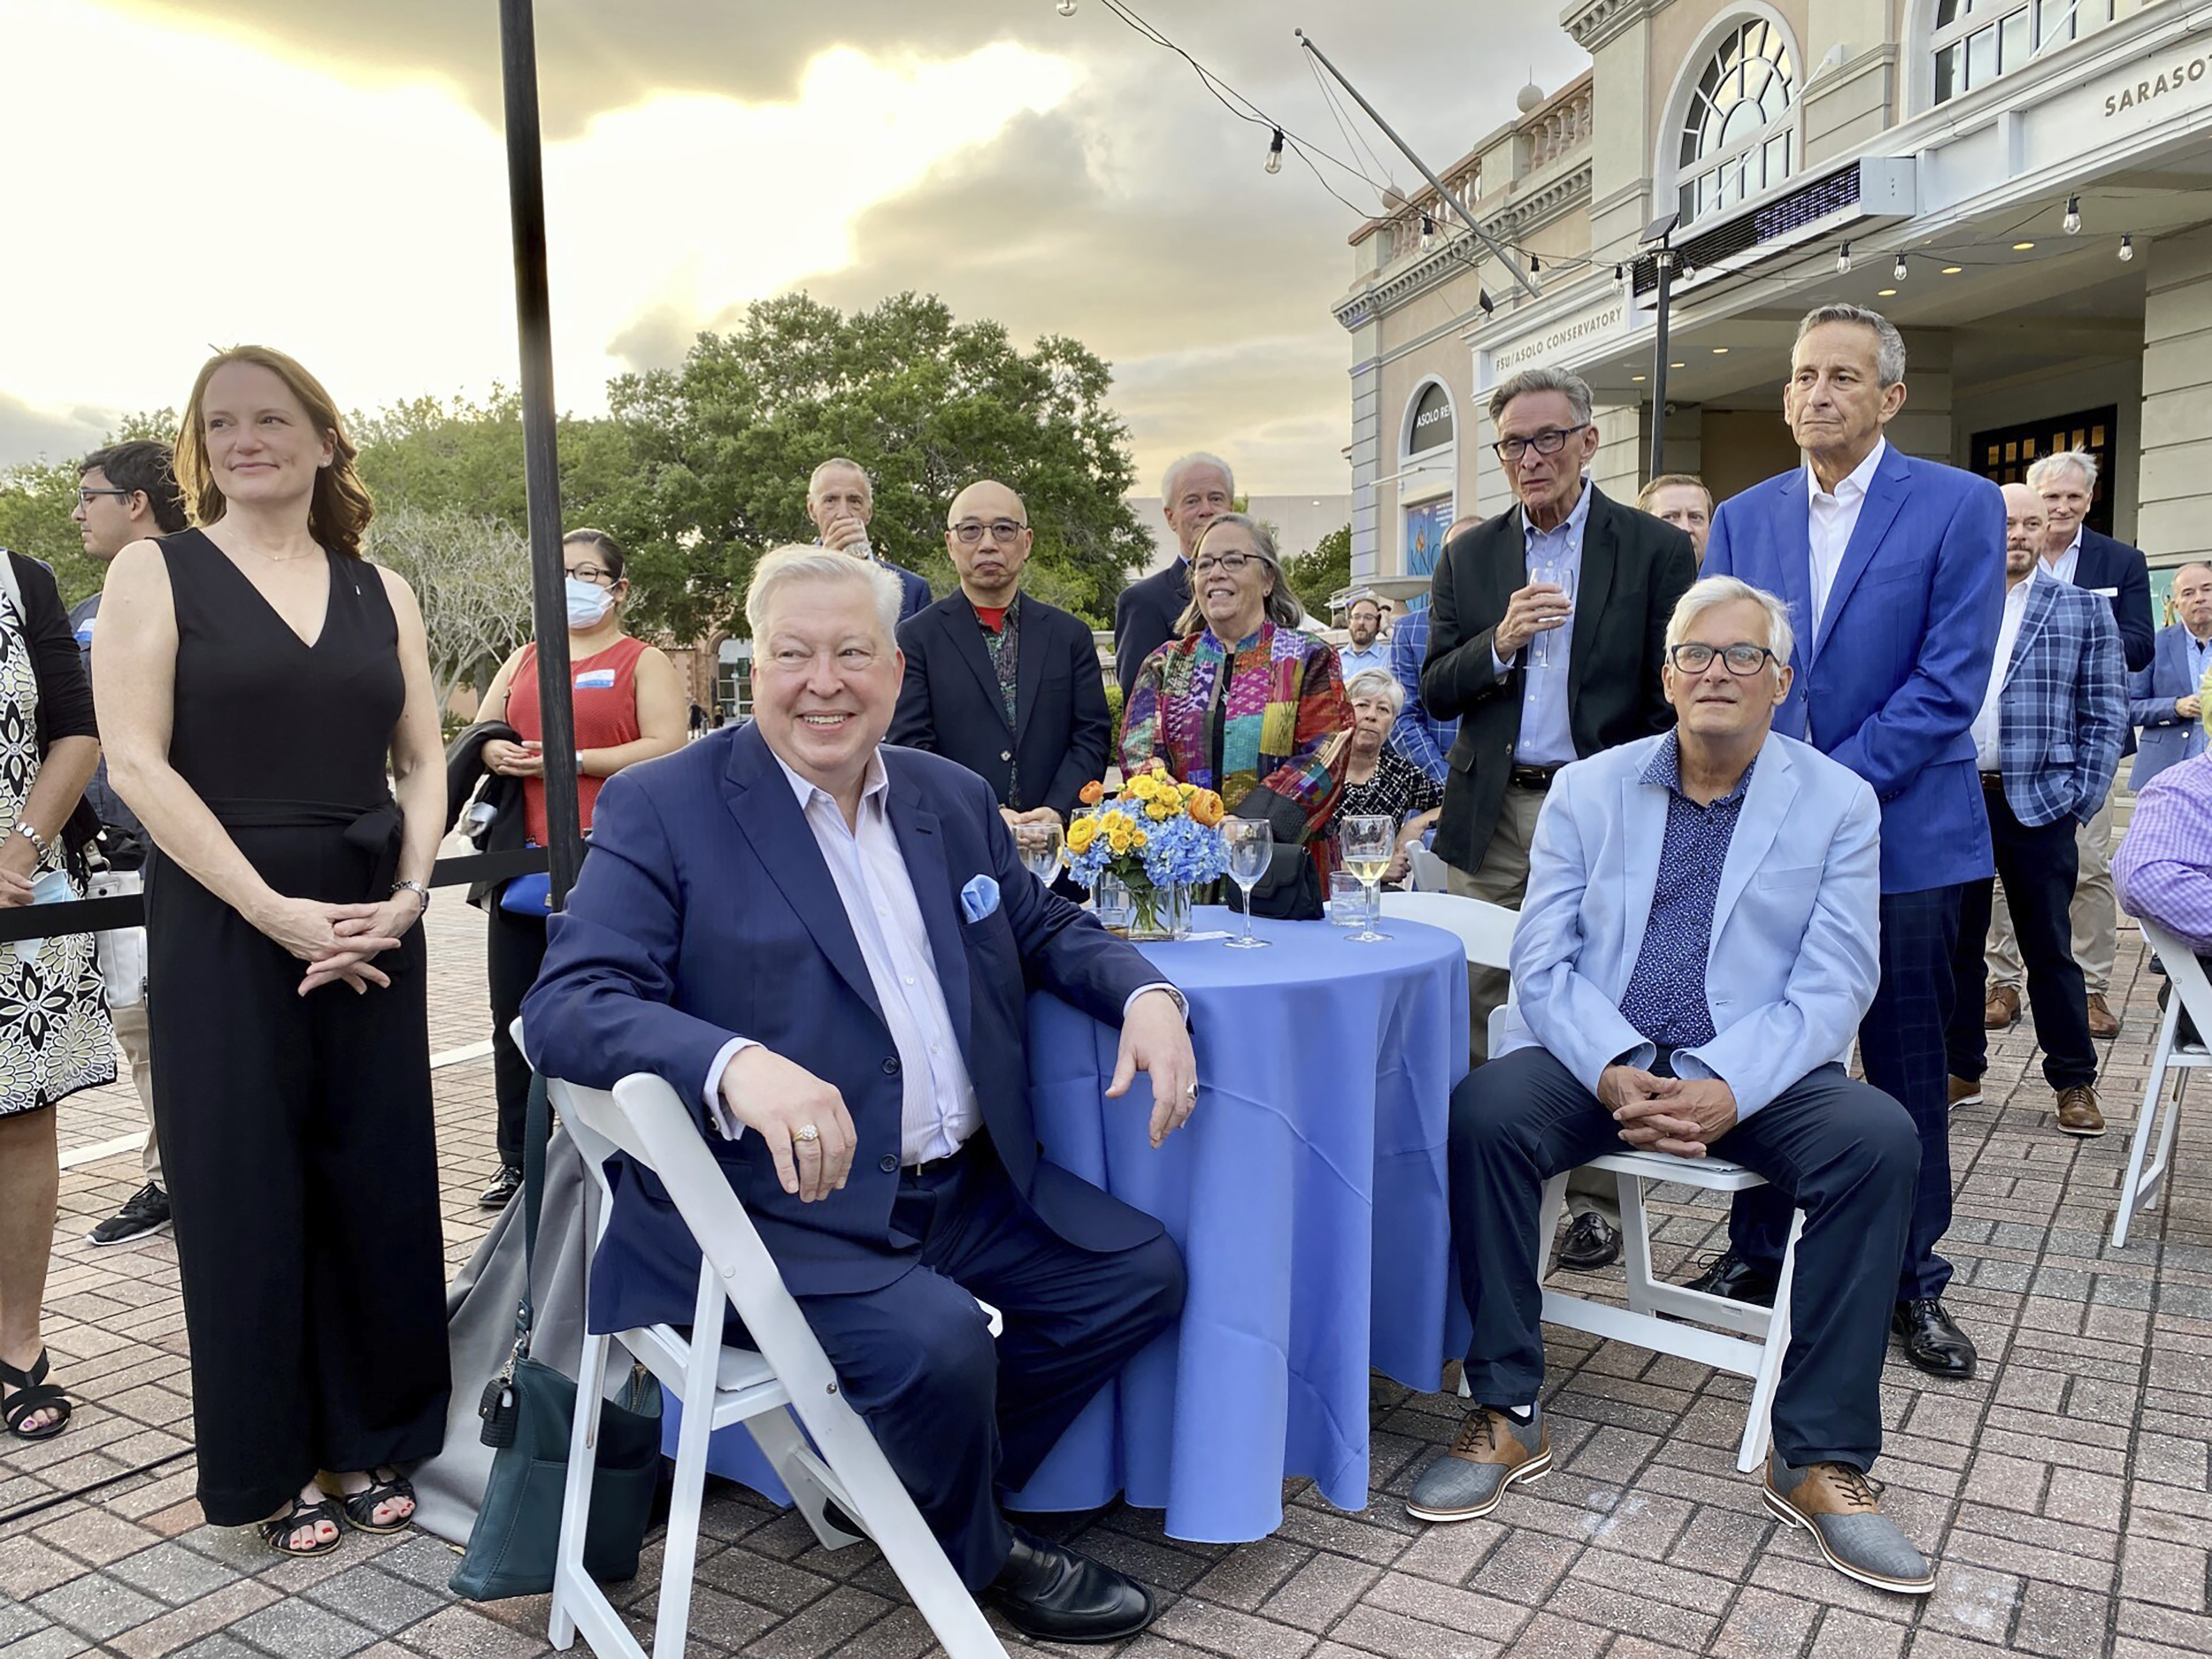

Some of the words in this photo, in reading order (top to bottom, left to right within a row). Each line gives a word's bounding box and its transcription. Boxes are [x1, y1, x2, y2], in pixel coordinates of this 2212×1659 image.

[2105, 54, 2212, 117] SARASO
[1496, 341, 1543, 371] FSU/ASOLO
[1547, 306, 1622, 349] CONSERVATORY
[1417, 408, 1439, 428] ASOLO
[1440, 404, 1451, 419] RE
